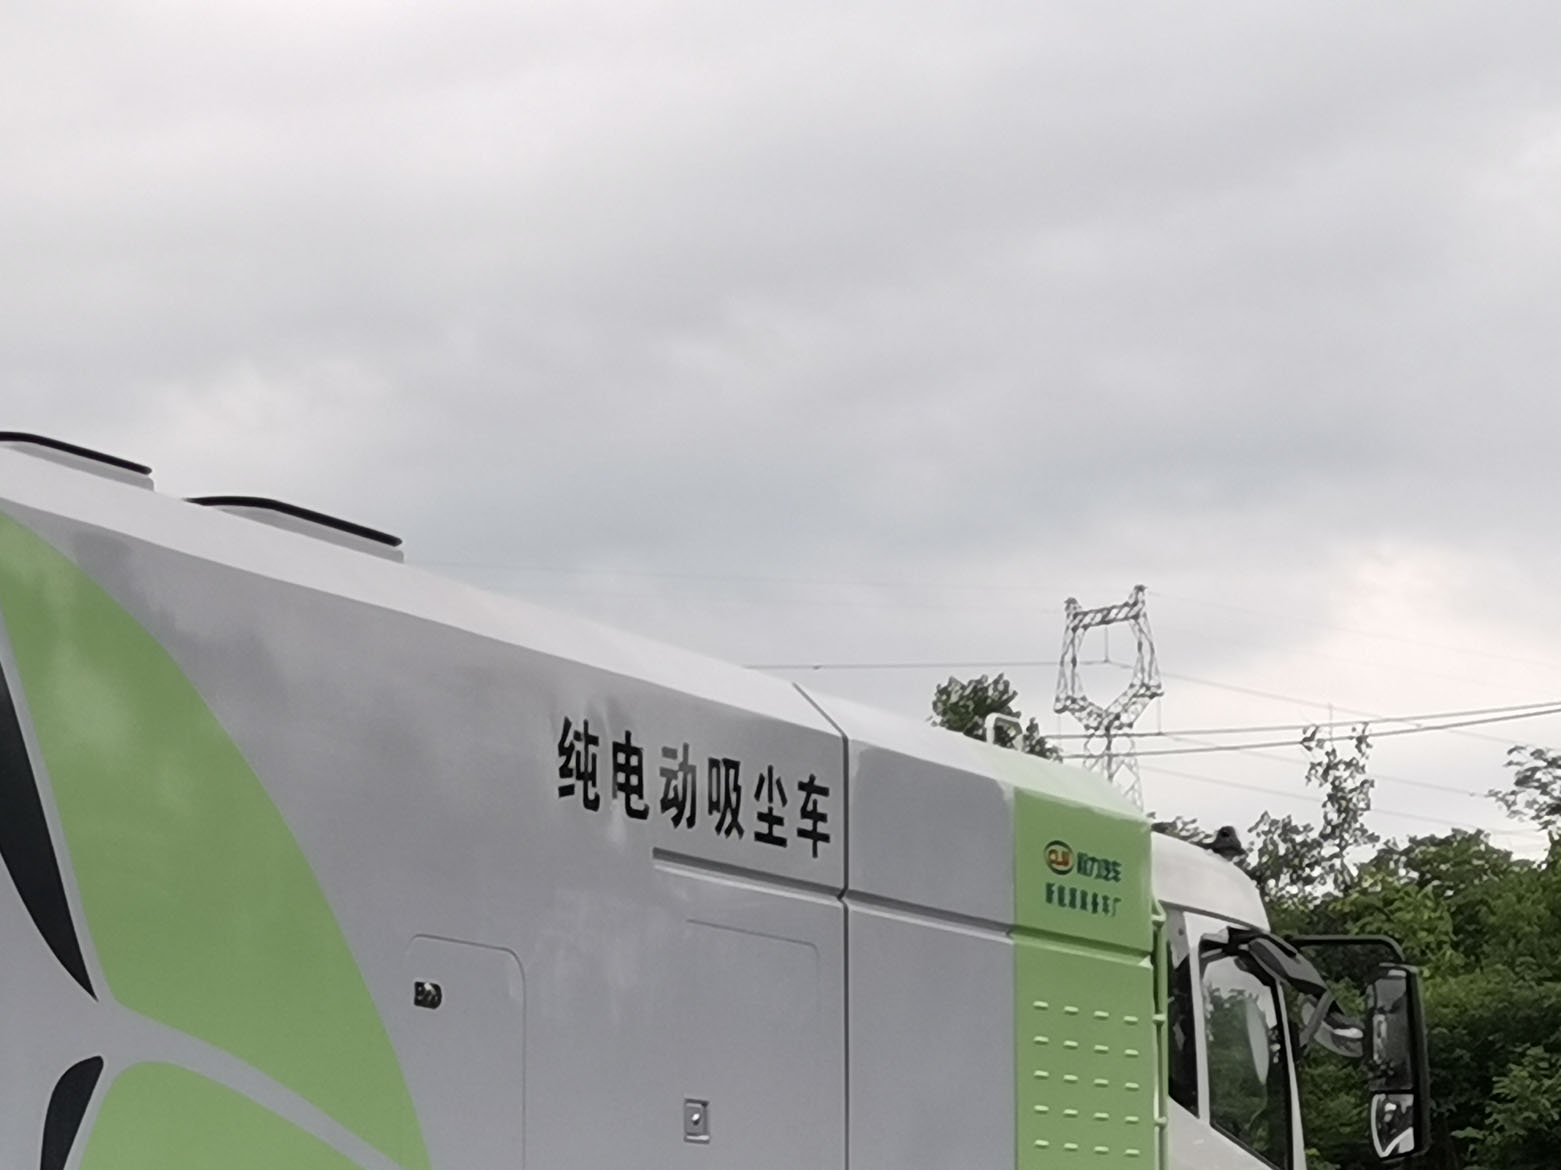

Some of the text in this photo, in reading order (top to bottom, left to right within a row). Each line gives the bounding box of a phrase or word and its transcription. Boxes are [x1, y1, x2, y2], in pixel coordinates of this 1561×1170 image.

[557, 716, 831, 858] 纯电动吸尘车
